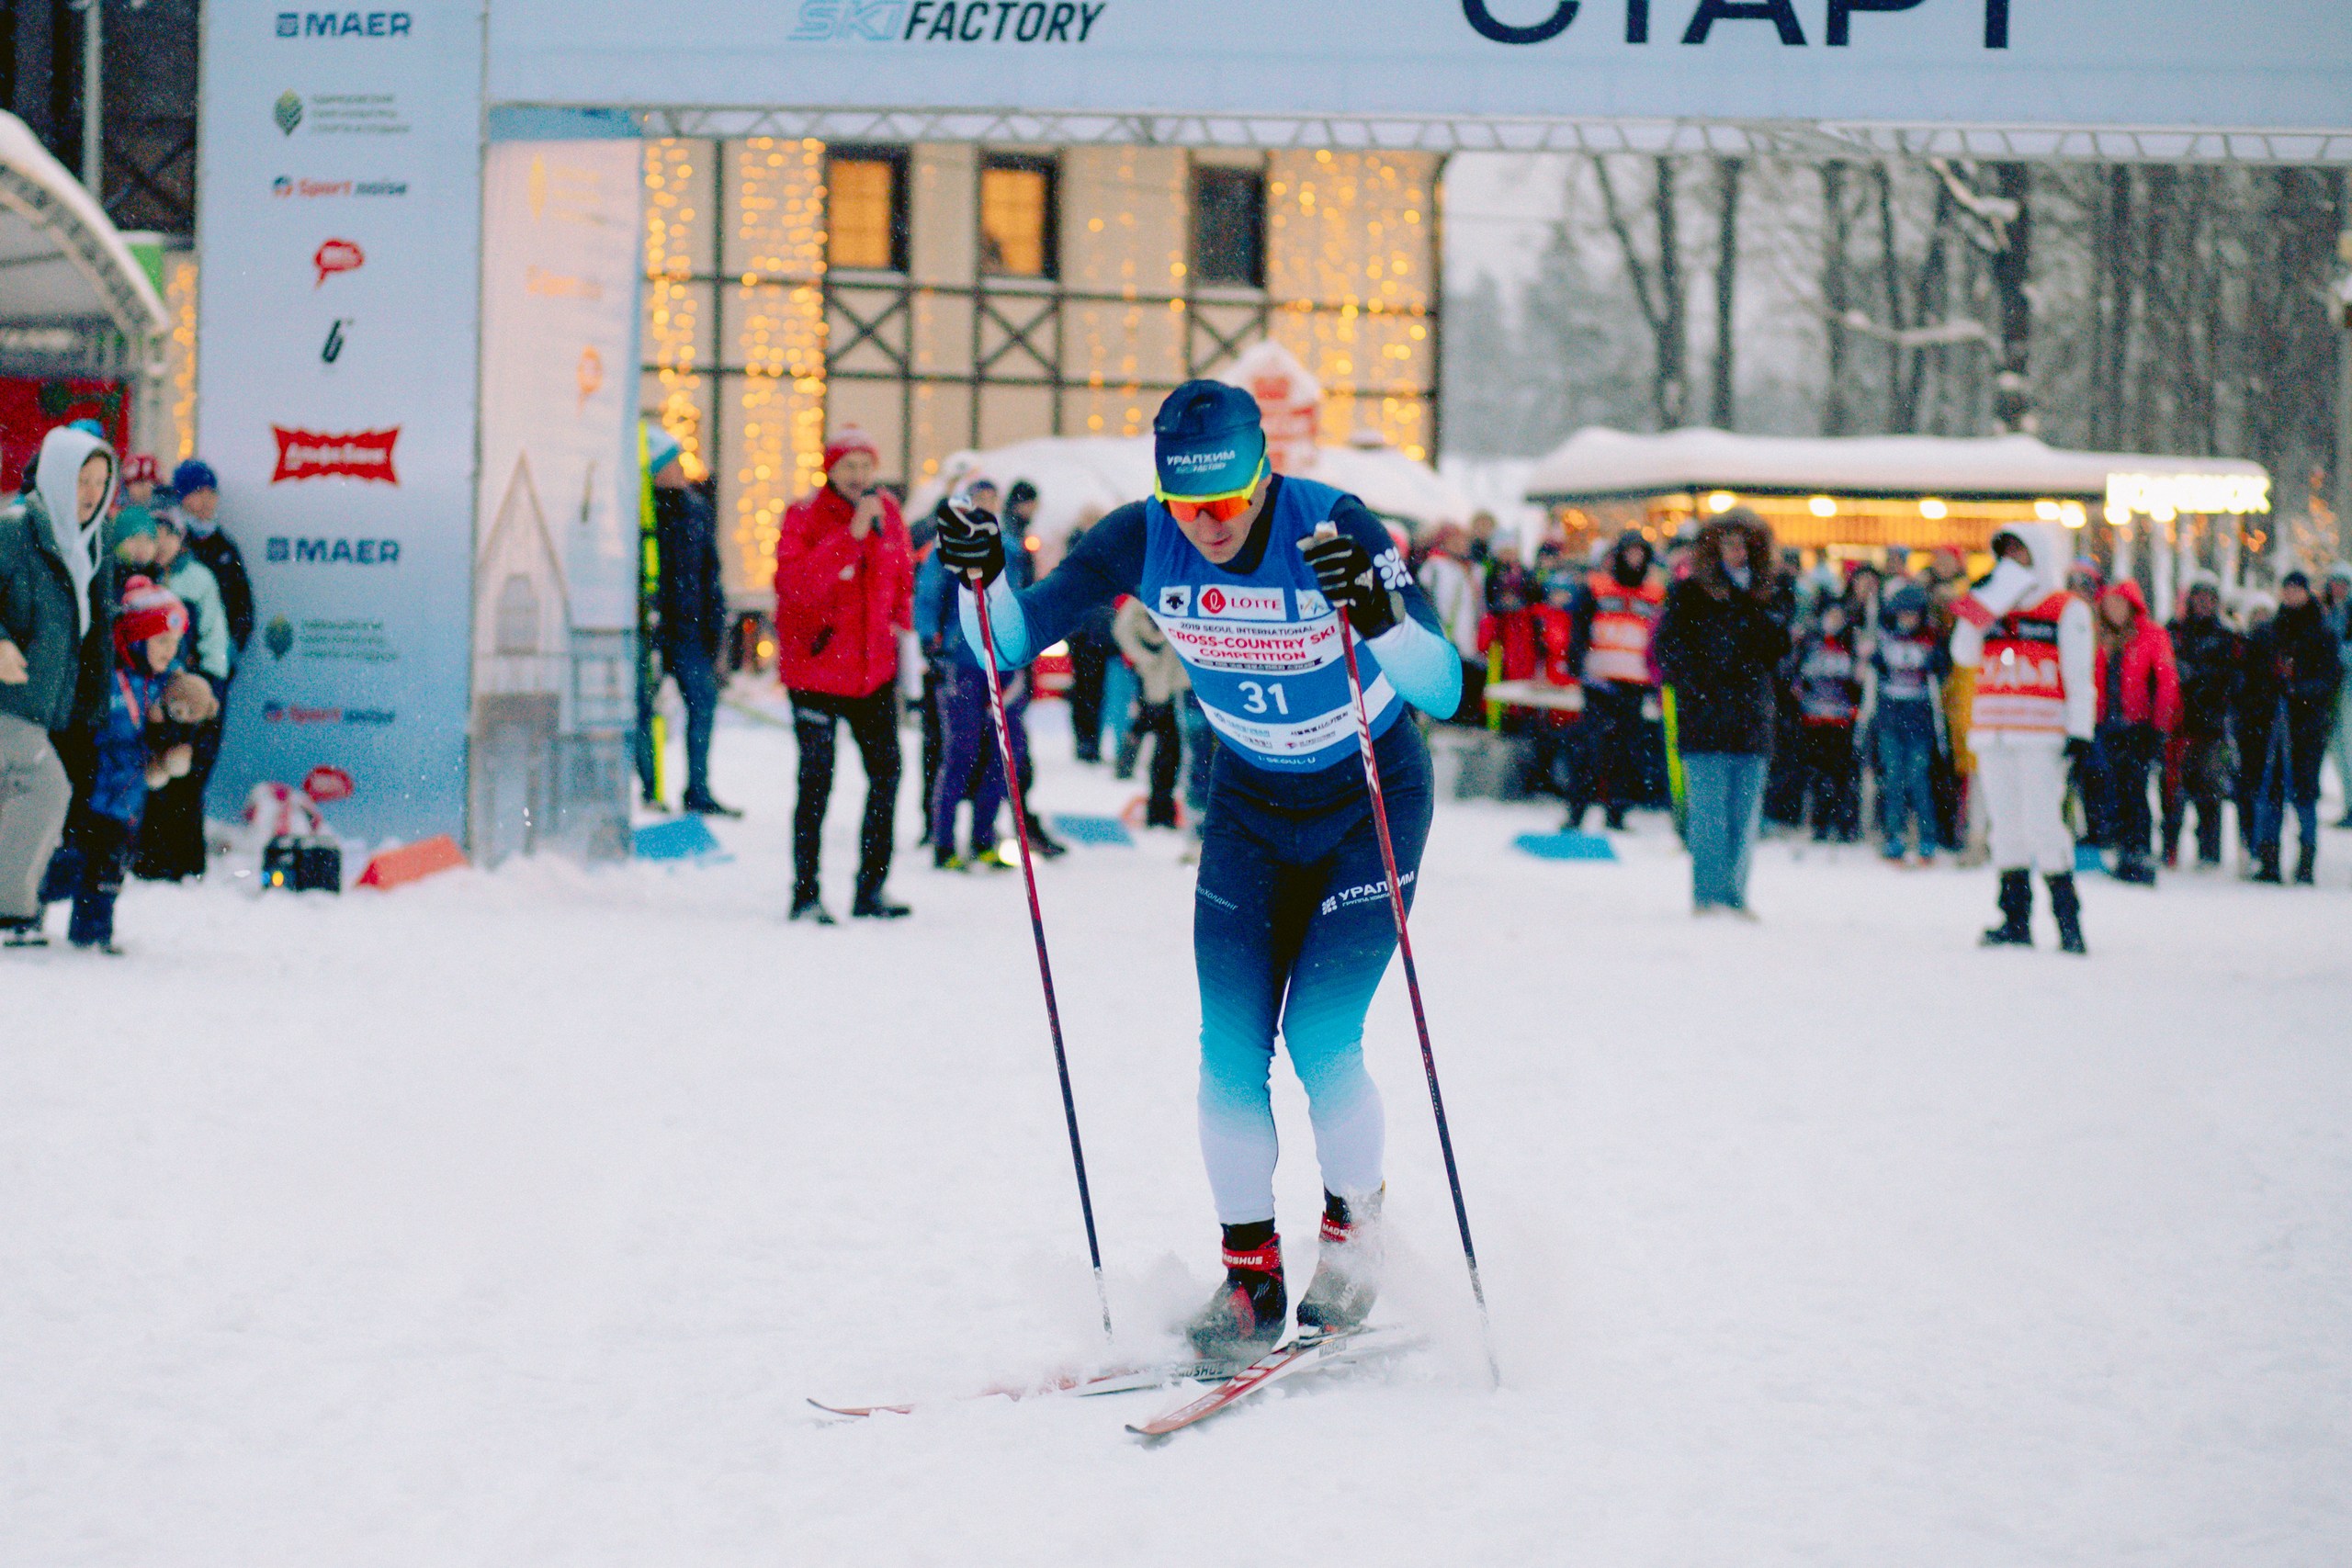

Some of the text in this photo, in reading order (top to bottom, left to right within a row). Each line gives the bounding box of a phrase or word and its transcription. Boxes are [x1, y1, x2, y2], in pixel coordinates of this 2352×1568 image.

[305, 12, 413, 37] MAER
[903, 1, 1106, 42] FACTORY
[1166, 449, 1236, 466] УРАЛХИМ
[295, 537, 401, 565] MAER
[1230, 597, 1283, 611] LOTTE
[1180, 623, 1317, 637] 2019 SEOUL INTERNATIONAL
[1310, 625, 1337, 645] SKI
[1199, 648, 1307, 661] COMPETITION
[1238, 680, 1289, 716] 31
[1196, 884, 1239, 911] еоХолдинг
[1339, 871, 1415, 901] УРАЛИМ
